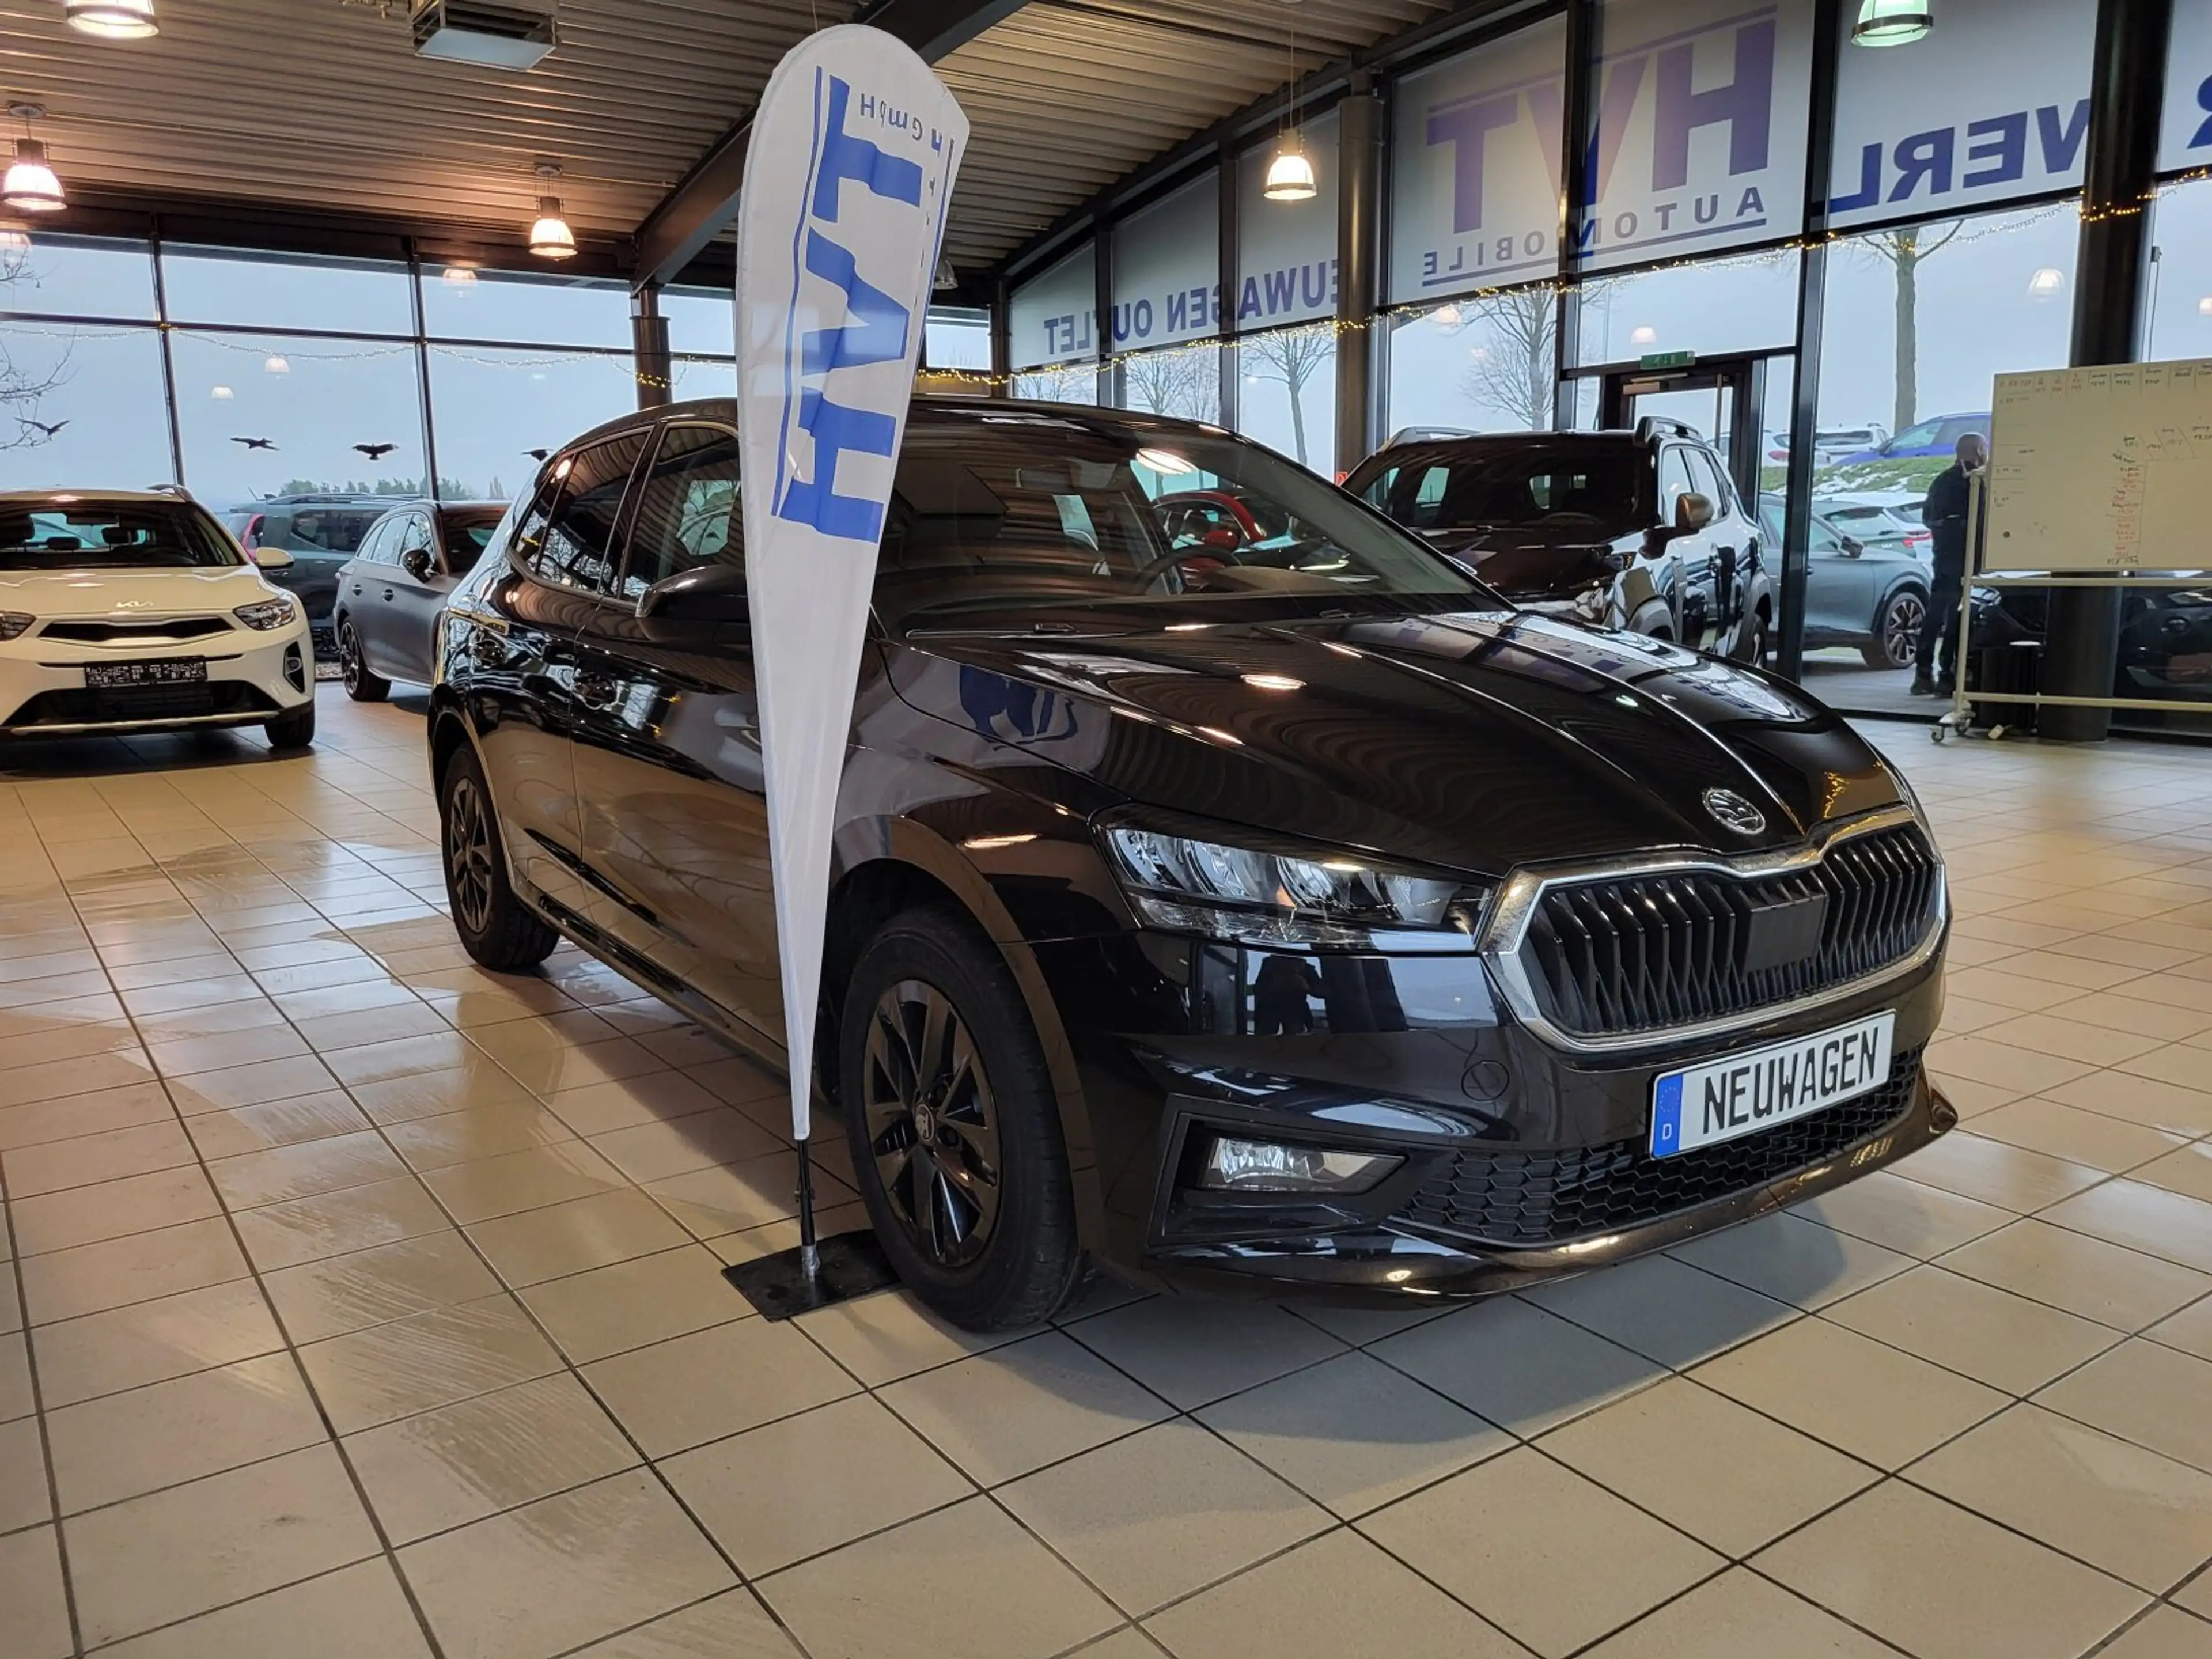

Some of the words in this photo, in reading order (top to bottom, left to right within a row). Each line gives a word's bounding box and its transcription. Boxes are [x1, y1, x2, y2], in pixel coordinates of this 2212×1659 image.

[860, 93, 923, 141] GmbH
[780, 75, 923, 543] HVT
[1662, 1123, 1672, 1140] D
[1703, 1027, 1879, 1134] NEUWAGEN
